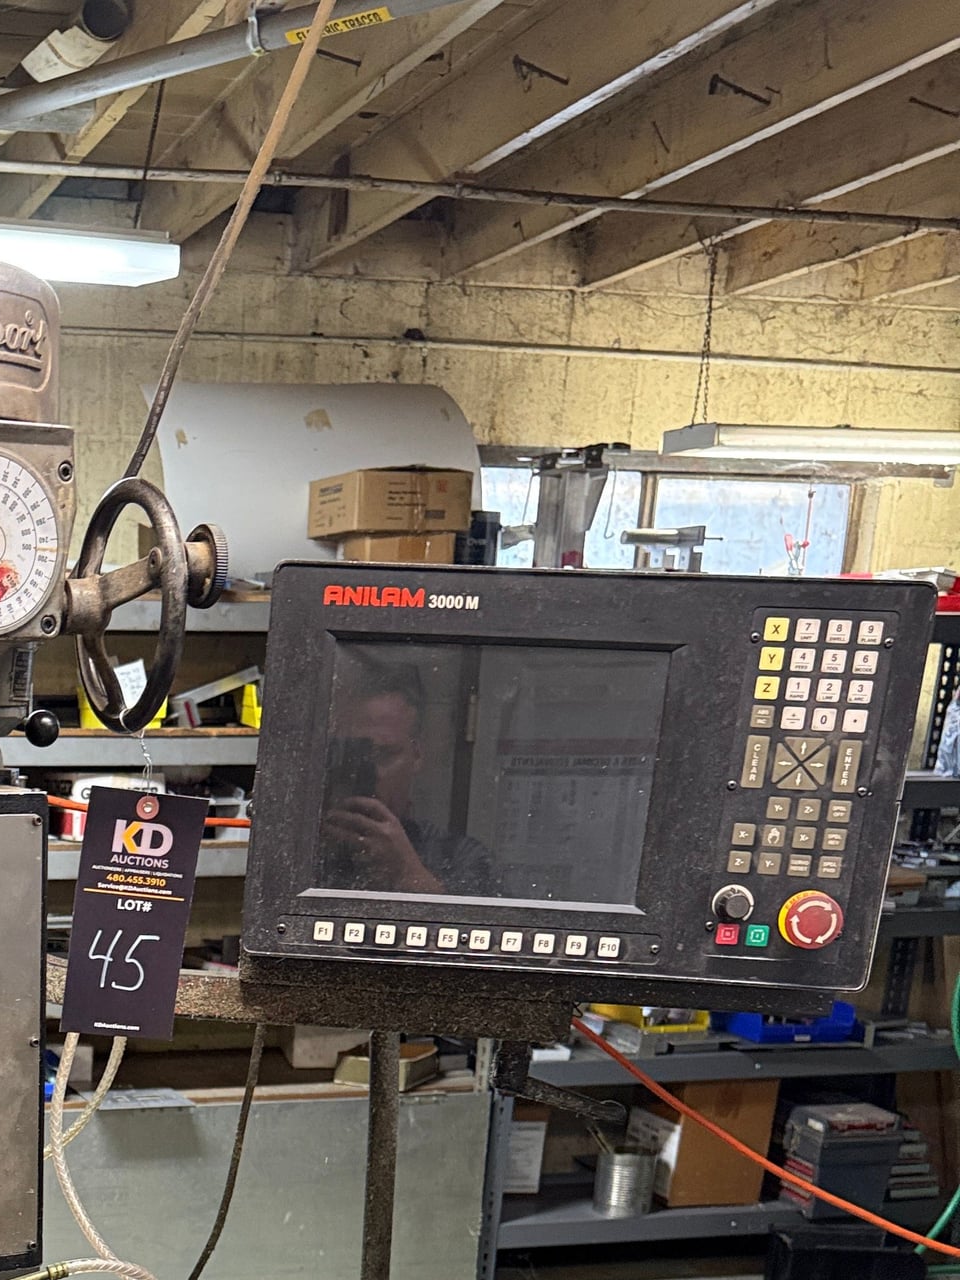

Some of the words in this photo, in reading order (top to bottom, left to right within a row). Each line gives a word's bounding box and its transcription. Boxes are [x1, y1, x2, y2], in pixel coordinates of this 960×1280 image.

[296, 23, 342, 41] ELRIC
[323, 585, 426, 608] ANILAM
[428, 595, 464, 609] 3000
[772, 625, 781, 634] X
[805, 623, 812, 631] 7
[836, 624, 843, 632] 8
[868, 625, 875, 633] 9
[768, 654, 776, 663] Y
[800, 652, 806, 660] 4
[831, 653, 838, 662] 5
[862, 654, 869, 663] 6
[763, 683, 772, 693] Z
[796, 682, 800, 690] 1
[826, 683, 833, 691] 2
[857, 684, 864, 692] 3
[820, 715, 828, 724] 0
[748, 743, 761, 781] CLEAR
[840, 748, 853, 786] ENTER
[111, 818, 174, 857] KD
[110, 854, 169, 869] AUCTIONS
[106, 873, 166, 887] 480.455.3910
[117, 898, 152, 912] LOT#
[318, 927, 328, 935] F1
[349, 929, 360, 937] F2
[379, 930, 391, 939] F3
[411, 932, 422, 941] F4
[442, 934, 454, 943] F5
[474, 935, 485, 945] F6
[506, 937, 517, 946] F7
[538, 939, 549, 948] F8
[570, 941, 582, 950] F9
[600, 943, 617, 952] F10
[88, 929, 160, 991] 45
